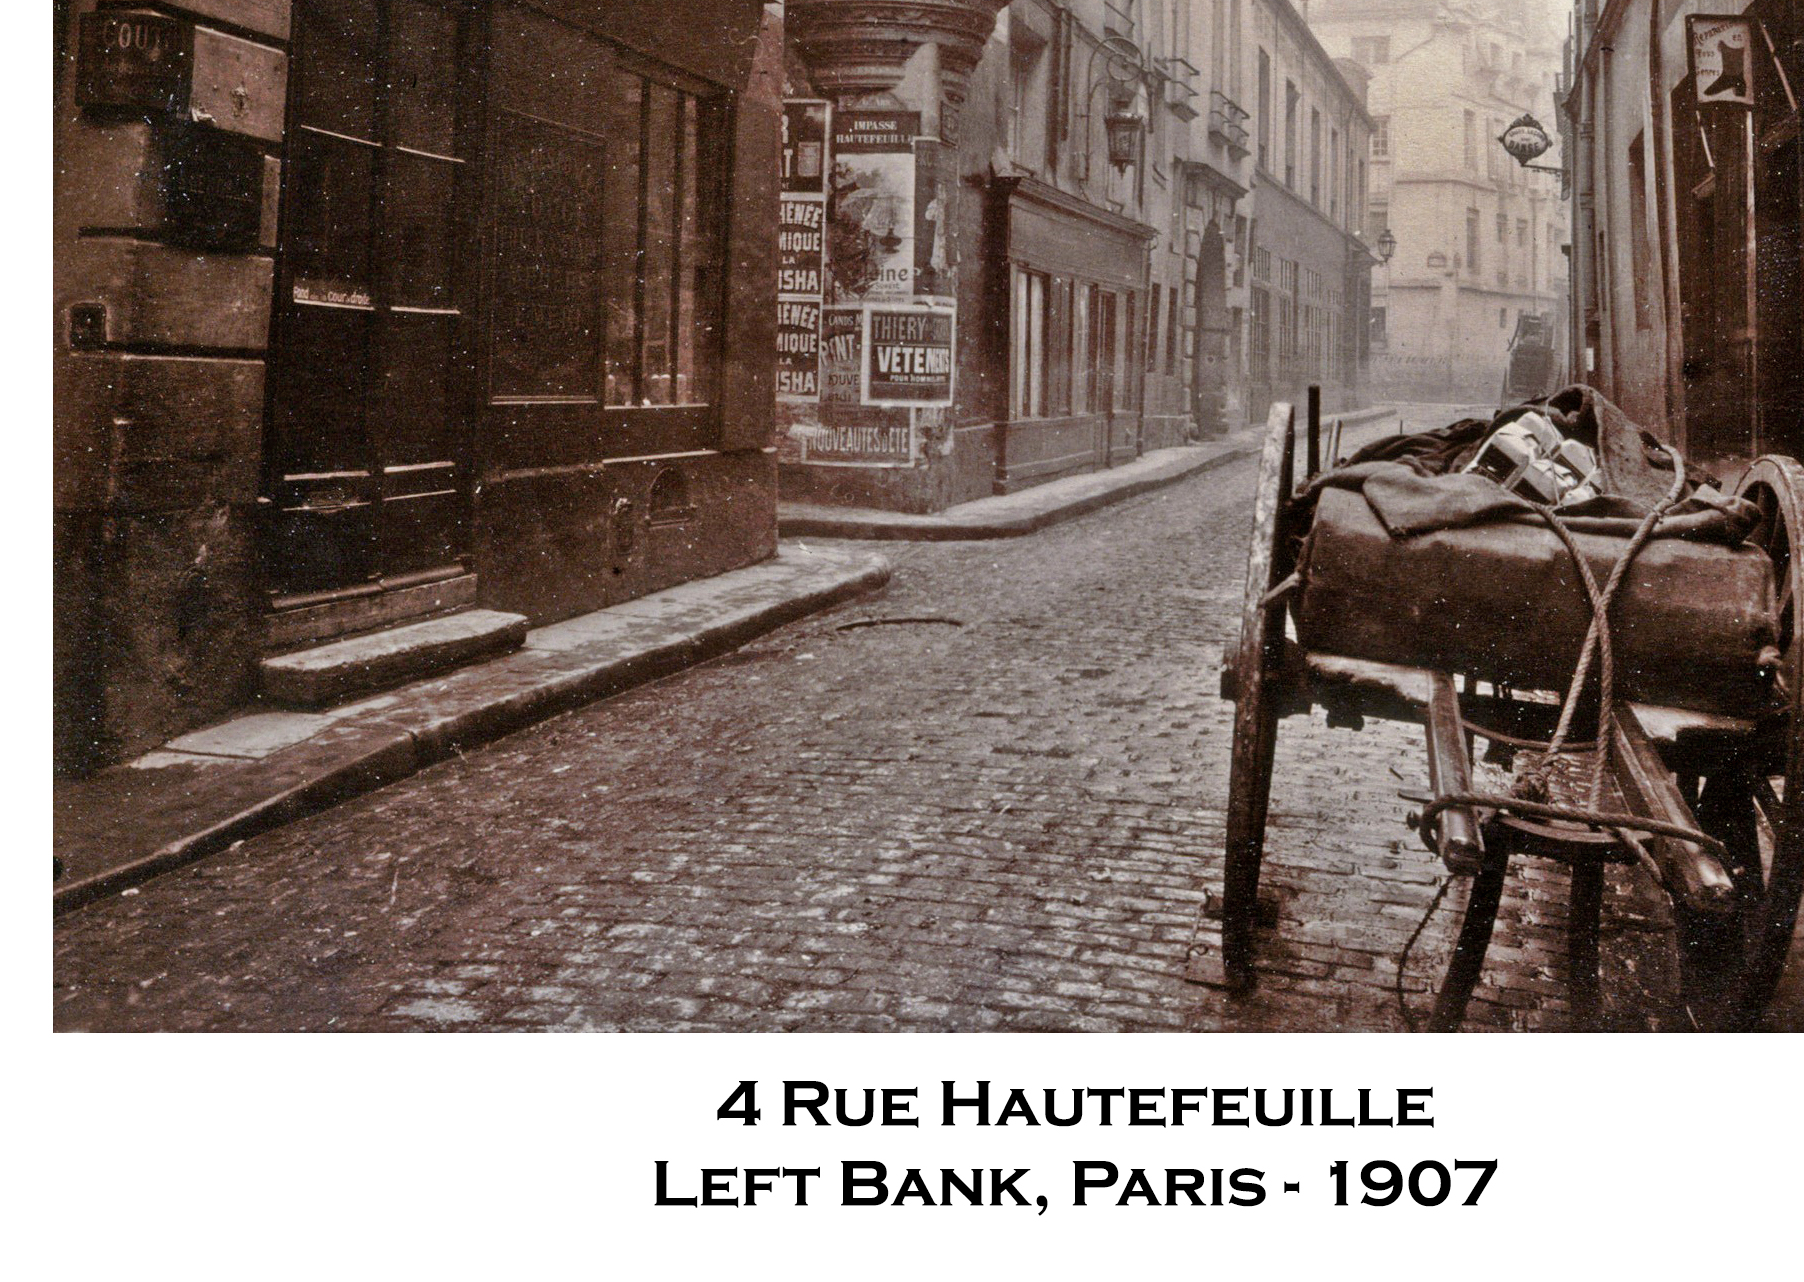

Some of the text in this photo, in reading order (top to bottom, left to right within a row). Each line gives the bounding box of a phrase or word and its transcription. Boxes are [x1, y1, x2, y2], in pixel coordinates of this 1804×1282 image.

[853, 120, 898, 131] IMPASSE
[782, 256, 796, 265] LA
[872, 314, 928, 341] THIERY
[779, 357, 793, 365] LA
